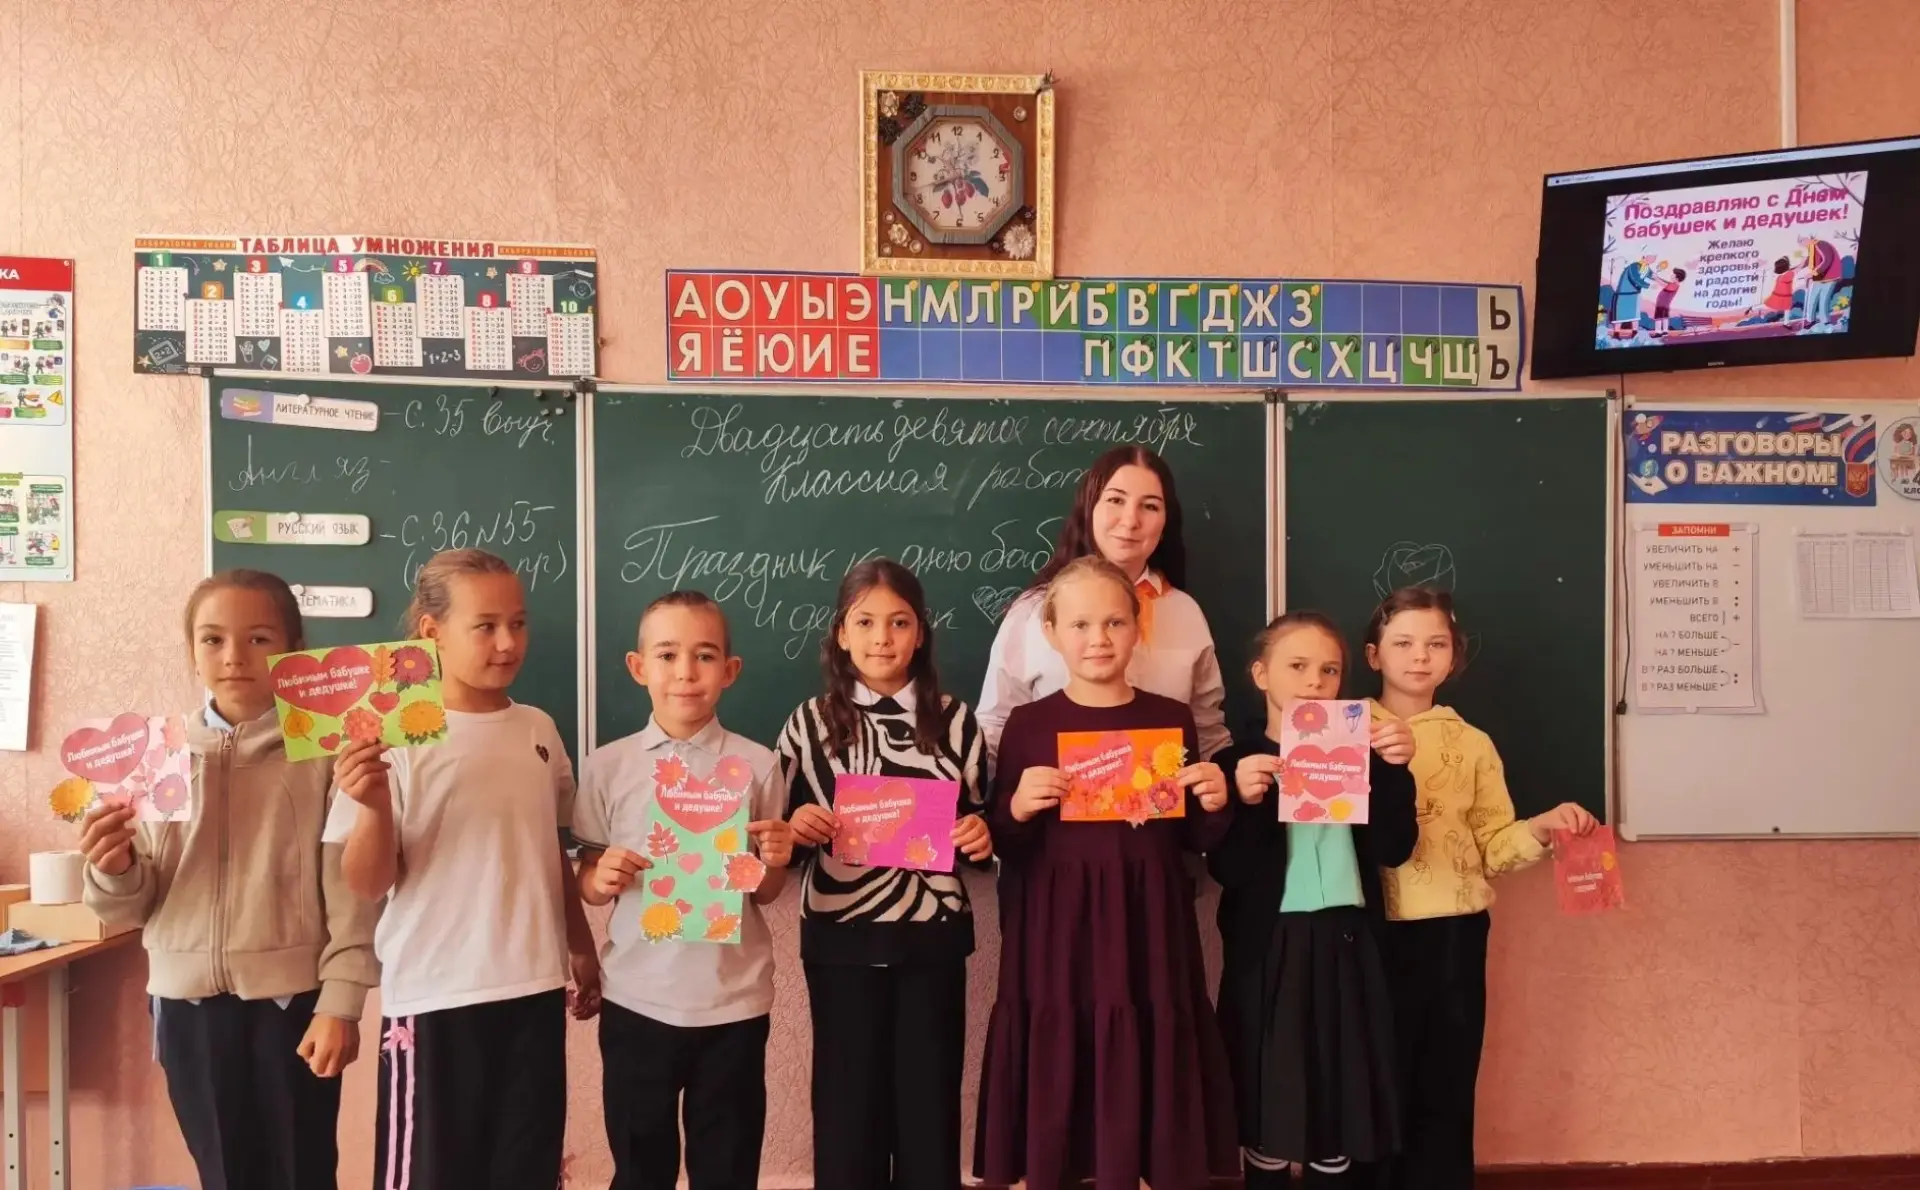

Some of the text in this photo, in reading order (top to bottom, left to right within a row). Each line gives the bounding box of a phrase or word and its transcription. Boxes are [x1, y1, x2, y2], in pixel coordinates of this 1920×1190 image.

[952, 125, 963, 136] 12
[930, 132, 941, 142] 11
[993, 149, 1000, 158] 2
[999, 174, 1006, 182] 3
[917, 195, 924, 204] 8
[992, 198, 1000, 207] 4
[1624, 194, 1761, 222] Поздравляю
[1768, 193, 1780, 206] с
[933, 211, 940, 221] 7
[978, 212, 985, 222] 5
[956, 218, 963, 227] 6
[1623, 204, 1849, 241] бабушек и дедушек!
[240, 237, 496, 257] ТАБЛИЦА УМНОЖЕНИЯ
[1708, 238, 1754, 250] Желаю
[155, 253, 163, 266] 1
[1700, 250, 1760, 264] крепкого
[251, 260, 261, 272] 3
[338, 259, 348, 272] 5
[433, 262, 442, 273] 7
[522, 262, 532, 273] 9
[1699, 262, 1759, 275] здоровья
[1695, 273, 1759, 287] и радости
[207, 285, 217, 298] 2
[387, 290, 397, 302] 6
[1694, 285, 1758, 299] на долгие
[297, 296, 306, 309] 4
[482, 295, 492, 307] 8
[561, 301, 578, 313] 10
[673, 280, 1511, 333] А О У Ы Э Н М Л Р Й Б В Г Д Ж З Ь
[1706, 297, 1743, 309] годы!
[677, 328, 1510, 385] Я Ё Ю И Е П Ф К Т Ш С Х Ц Ч Щ Ъ
[275, 404, 375, 422] ЛИТЕРАТУРНОЕ ЧТЕНИЕ
[681, 403, 1205, 473] Двадцать девятое сентября
[1661, 431, 1842, 457] РАЗГОВОРЫ
[1665, 459, 1838, 486] О ВАЖНОМ!
[967, 448, 1090, 512] работ
[278, 522, 360, 536] РУССКИЙ ЯЗЫК
[1671, 525, 1717, 535] ЗАПОМНИ
[1646, 545, 1718, 554] УВЕЛИЧИТЬ НА
[621, 515, 830, 602] Праздник
[1643, 561, 1718, 571] УМЕНЬШИТЬ НА
[1653, 579, 1719, 588] УВЕЛИЧИТЬ В
[300, 594, 357, 608] ТЕМАТИКА
[1650, 596, 1719, 606] УМЕНЬШИТЬ В
[1689, 613, 1719, 623] ВСЕГО
[1655, 630, 1669, 639] НА
[1679, 630, 1719, 640] БОЛЬШЕ
[1655, 648, 1668, 656] НА
[1677, 648, 1718, 657] МЕНЬШЕ
[1641, 665, 1648, 674] В
[1657, 665, 1675, 674] РАЗ
[1677, 665, 1718, 674] БОЛЬШЕ
[277, 664, 370, 689] Любимым бабушке
[308, 679, 358, 698] дедушке!
[1641, 682, 1648, 691] В
[1657, 682, 1674, 692] РАЗ
[1676, 682, 1718, 692] МЕНЬШЕ
[67, 729, 146, 763] Любимым бабушке
[94, 744, 136, 768] дедушке!
[682, 803, 723, 814] дедушке!
